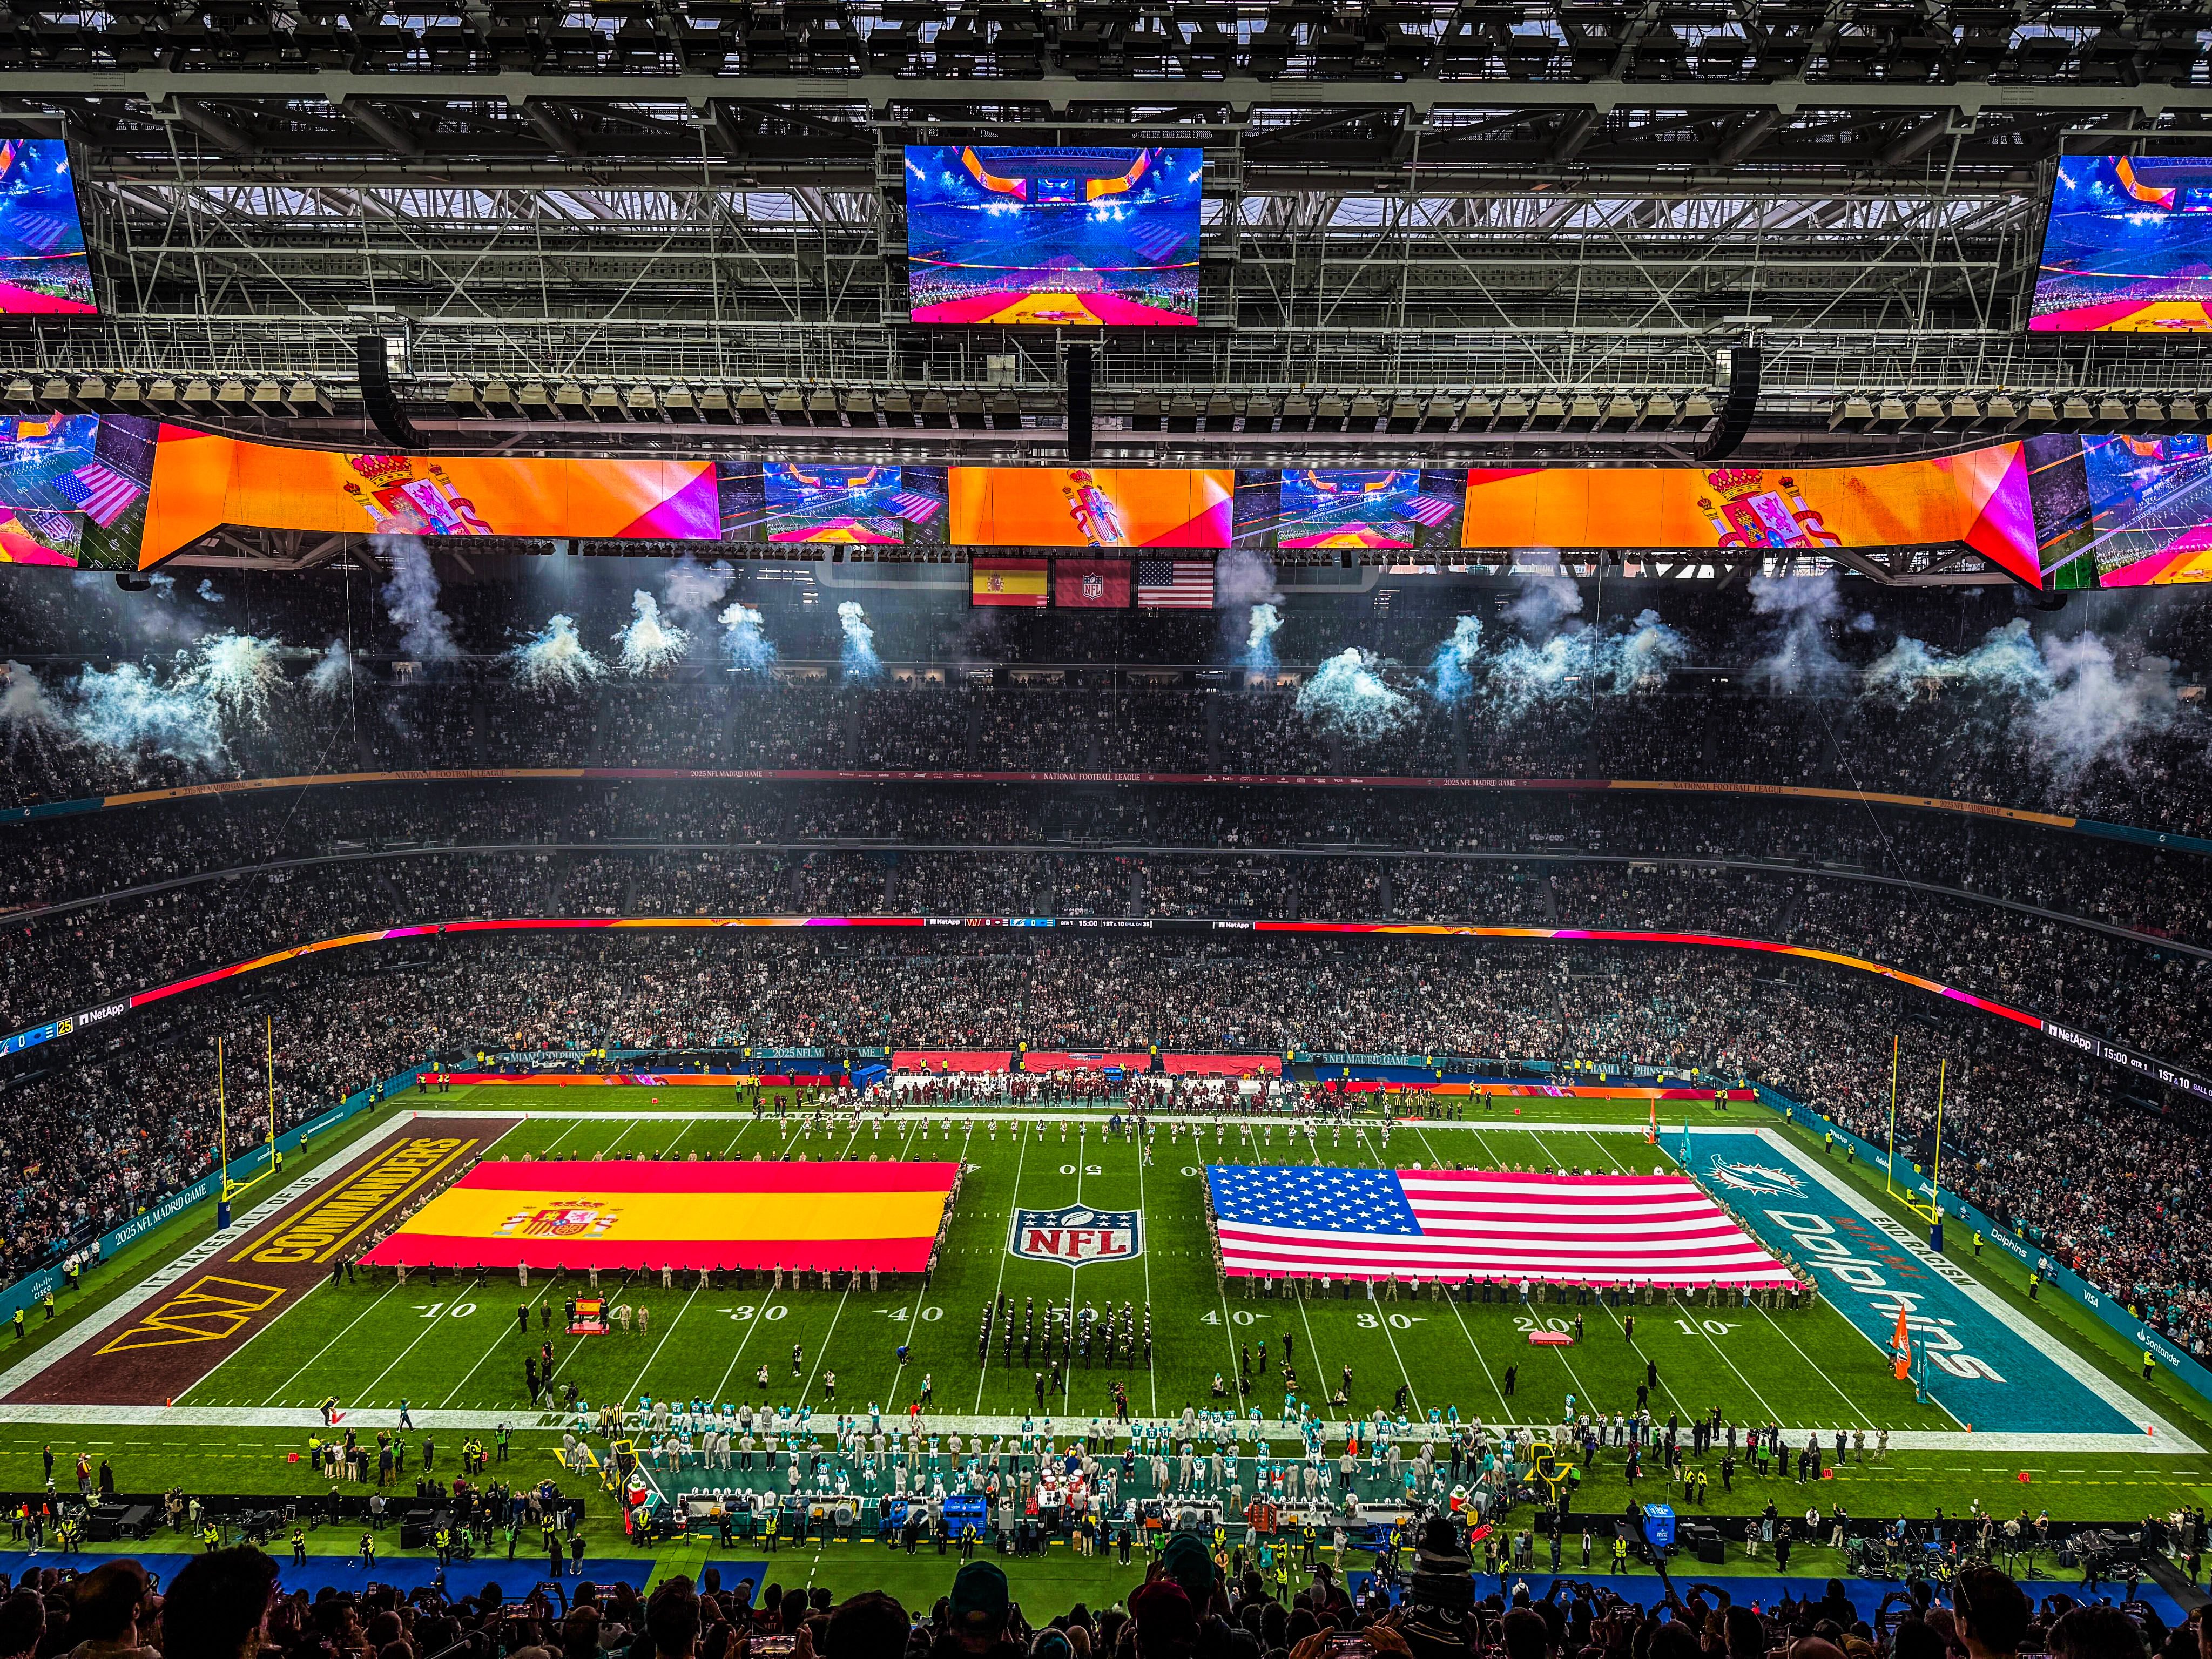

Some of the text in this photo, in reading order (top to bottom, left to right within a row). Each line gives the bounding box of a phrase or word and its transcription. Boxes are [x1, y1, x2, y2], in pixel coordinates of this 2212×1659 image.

[1084, 584, 1102, 596] NFL
[1673, 781, 1784, 794] NATIONAL FOOTBALL LEAGUE
[1940, 800, 1953, 808] 2025
[1965, 803, 1987, 814] MADRID
[1987, 806, 2001, 815] GAME
[90, 1004, 124, 1022] NetApp
[58, 1020, 71, 1034] 25
[18, 1035, 25, 1048] 0
[2058, 1028, 2092, 1050] NetApp
[511, 1052, 538, 1062] MIAMI
[773, 1048, 795, 1057] 2025
[797, 1048, 810, 1057] NFL
[1330, 1054, 1345, 1064] NFL
[1347, 1055, 1381, 1064] MADRID
[1384, 1056, 1408, 1065] GAME
[2103, 1048, 2127, 1064] 15:00
[2130, 1059, 2142, 1069] QTR
[2159, 1069, 2175, 1083] 1ST
[2179, 1077, 2189, 1089] 10
[2193, 1083, 2208, 1095] BALL
[1832, 1131, 1847, 1144] NetApp
[1059, 1165, 1102, 1175] 50
[252, 1137, 462, 1263] COMMANDERS
[115, 1183, 206, 1246] 2025 NFL MADRID GAME
[140, 1177, 320, 1289] IT TAKES ALL OF US
[1024, 1229, 1127, 1258] NFL
[1829, 1215, 1929, 1280] MIAMI
[1869, 1216, 1977, 1286] END RACISM
[1991, 1228, 2027, 1258] Dolphins
[34, 1285, 51, 1300] cisco
[1762, 1209, 2008, 1384] Dolphins
[2083, 1289, 2099, 1308] VISA
[419, 1303, 477, 1318] 10
[729, 1305, 788, 1321] 30
[887, 1306, 944, 1322] 40
[1199, 1310, 1255, 1326] 40
[1355, 1313, 1412, 1330] 30
[1512, 1317, 1570, 1333] 20
[1674, 1319, 1729, 1336] 10
[2146, 1335, 2181, 1367] Santander
[1503, 1443, 1512, 1451] 49
